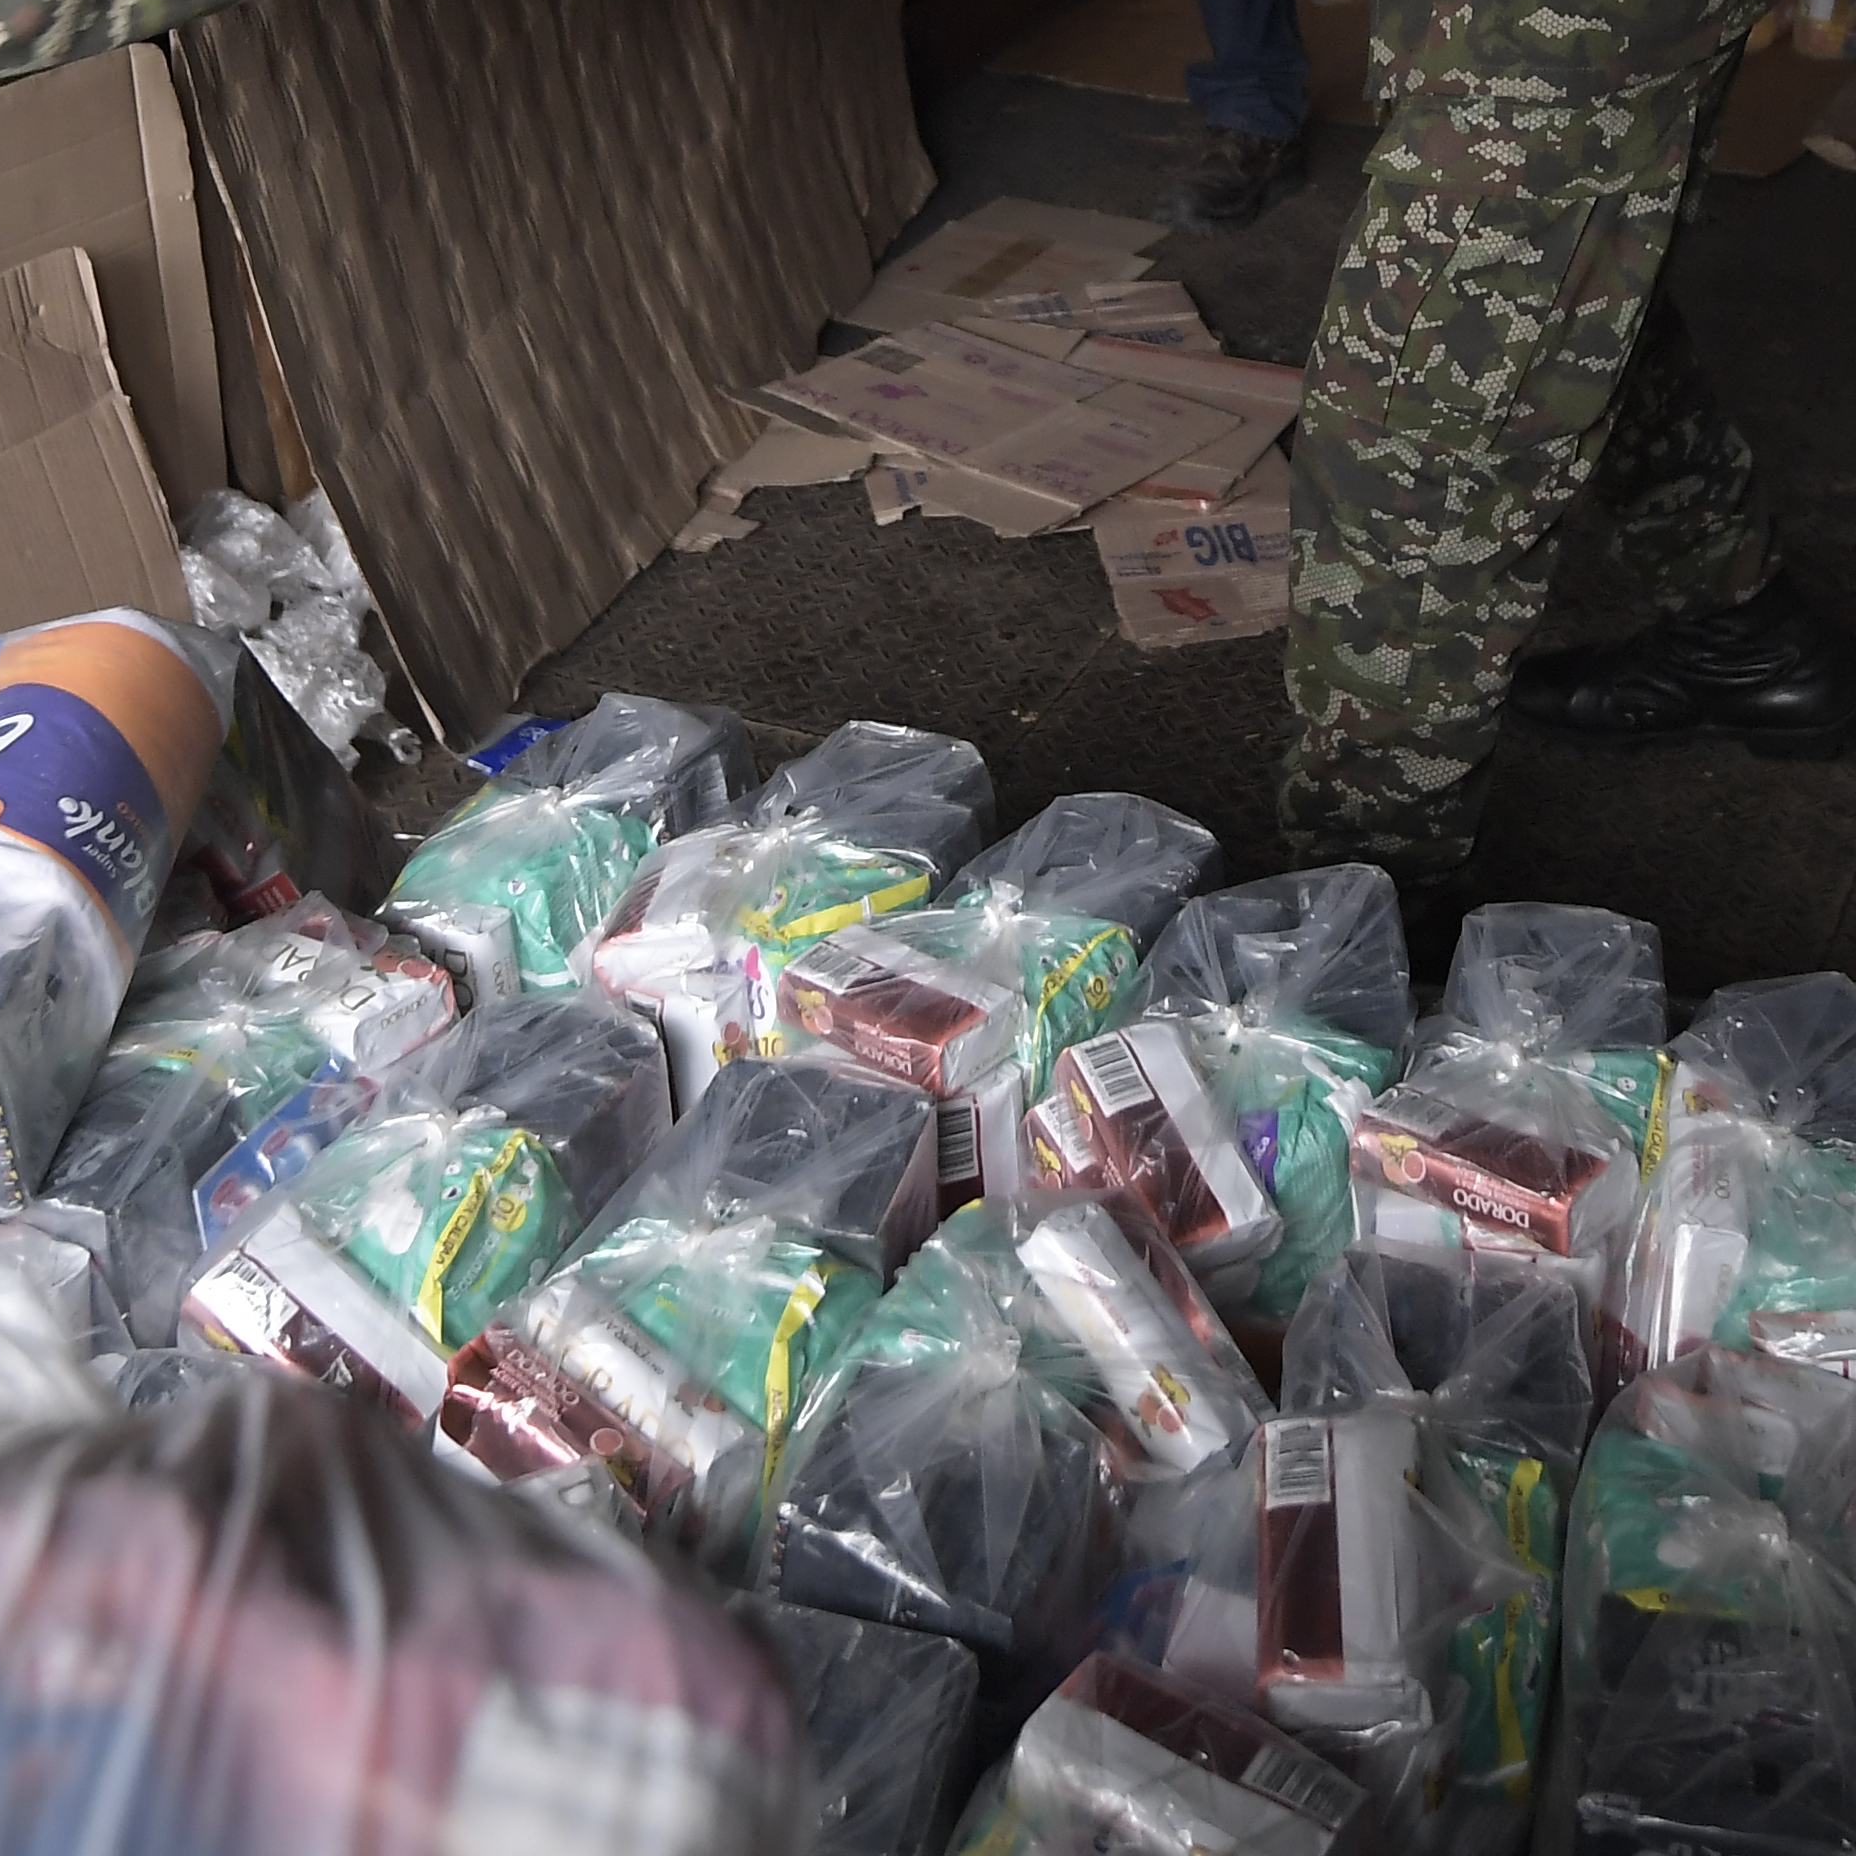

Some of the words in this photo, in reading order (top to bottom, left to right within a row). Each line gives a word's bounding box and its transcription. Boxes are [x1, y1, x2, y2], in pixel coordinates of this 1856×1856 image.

[1185, 522, 1258, 566] BIG
[380, 993, 429, 1031] DORADO
[489, 1195, 517, 1223] 10
[1452, 1188, 1531, 1230] DORADO
